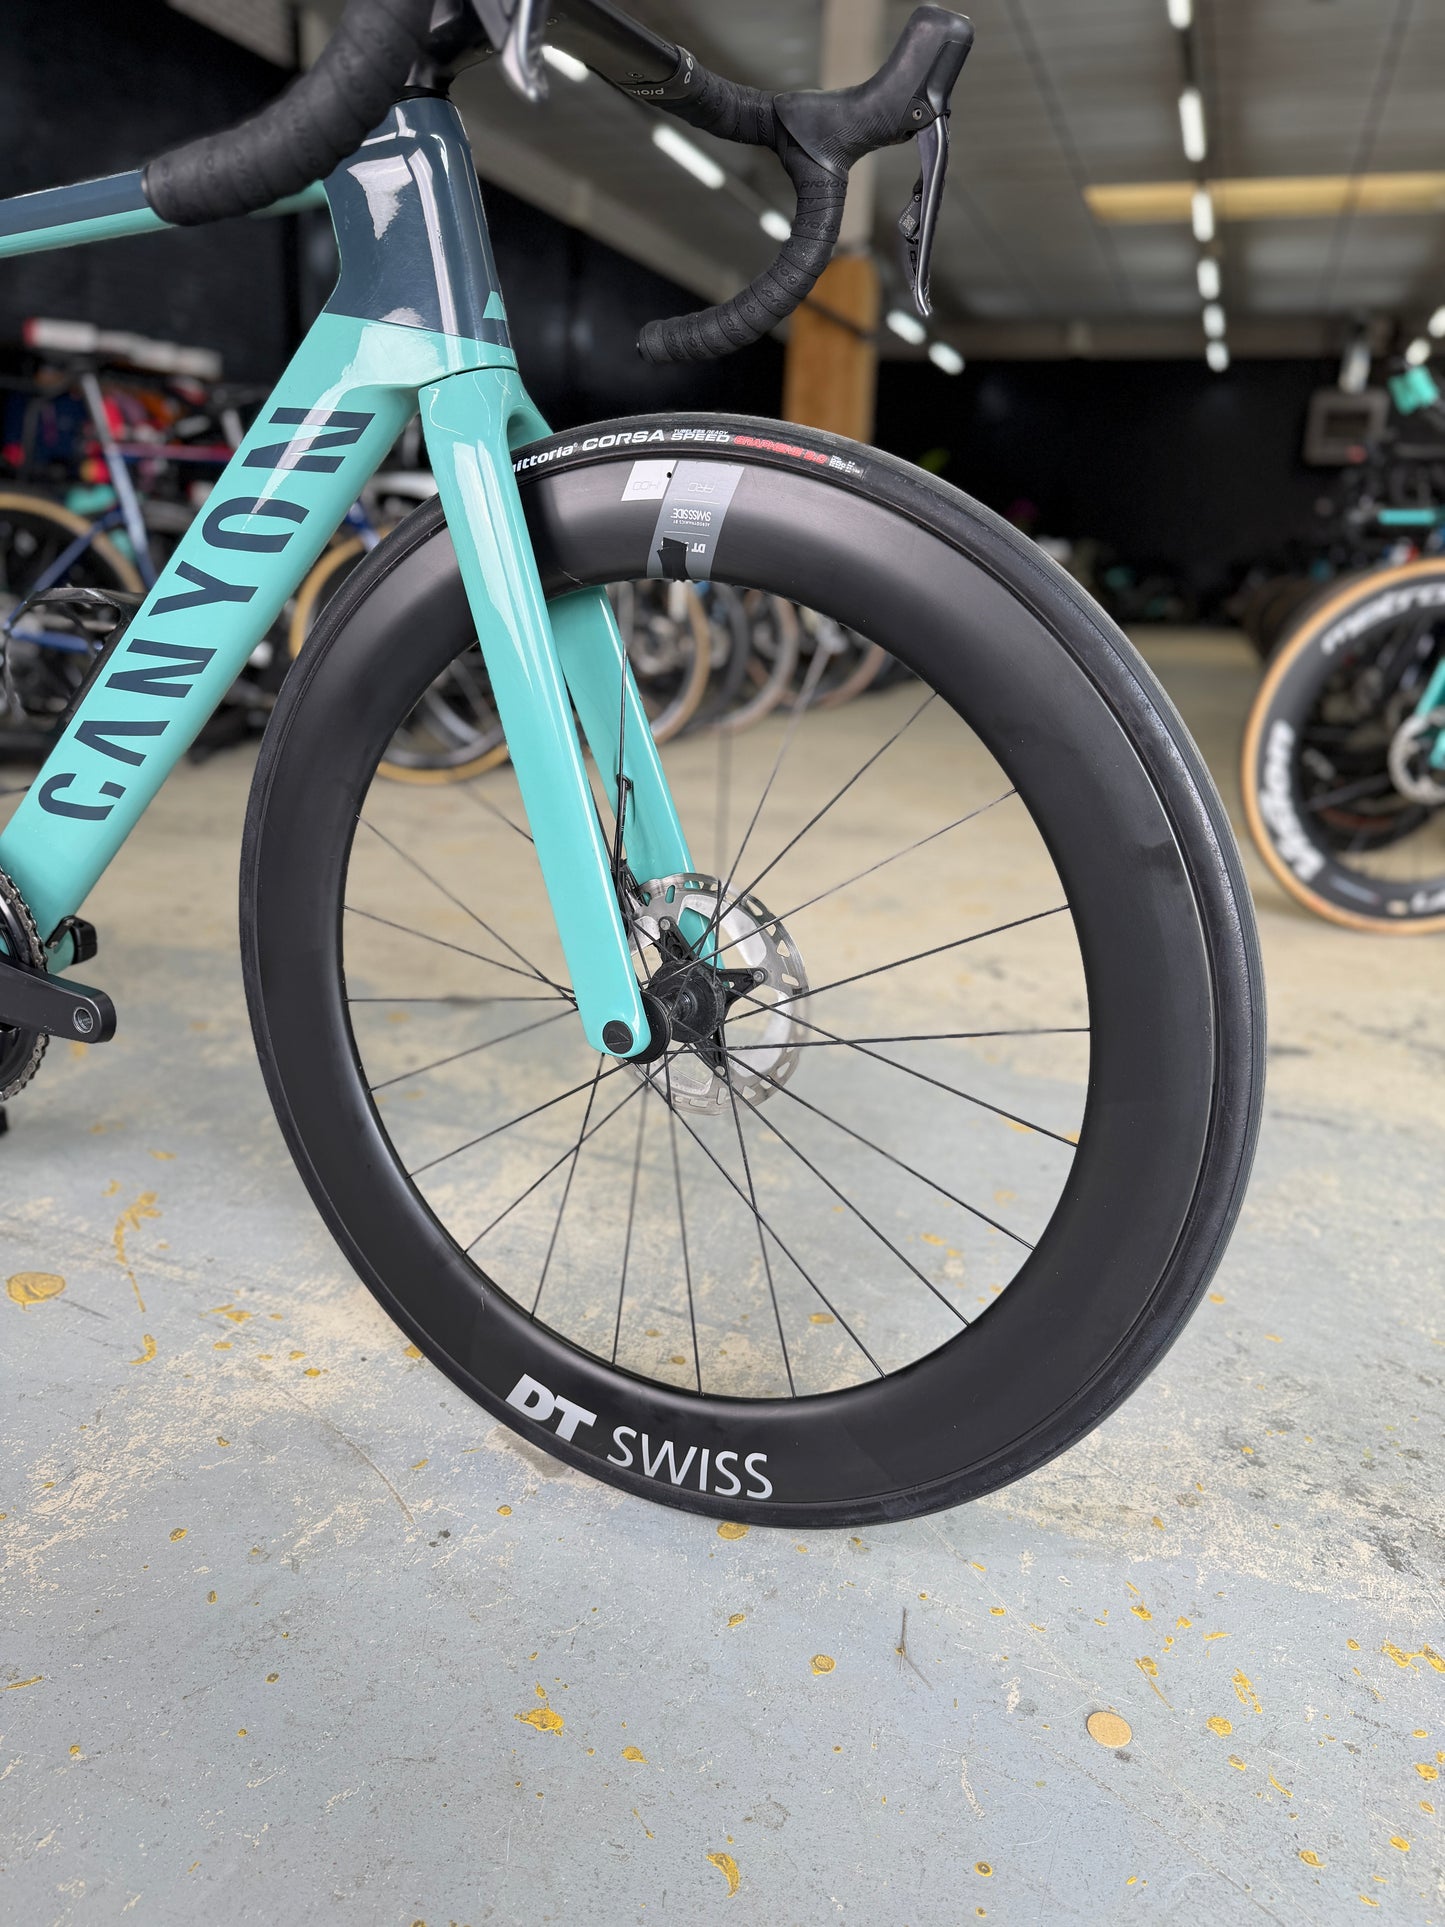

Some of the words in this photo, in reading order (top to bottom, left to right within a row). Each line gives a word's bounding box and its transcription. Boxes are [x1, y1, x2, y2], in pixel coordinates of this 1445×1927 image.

[582, 429, 665, 451] CORSA
[671, 433, 730, 443] SPEED
[691, 543, 706, 554] DT
[38, 407, 375, 821] CANYON
[505, 1373, 598, 1442] DT
[606, 1425, 773, 1499] SWISS
